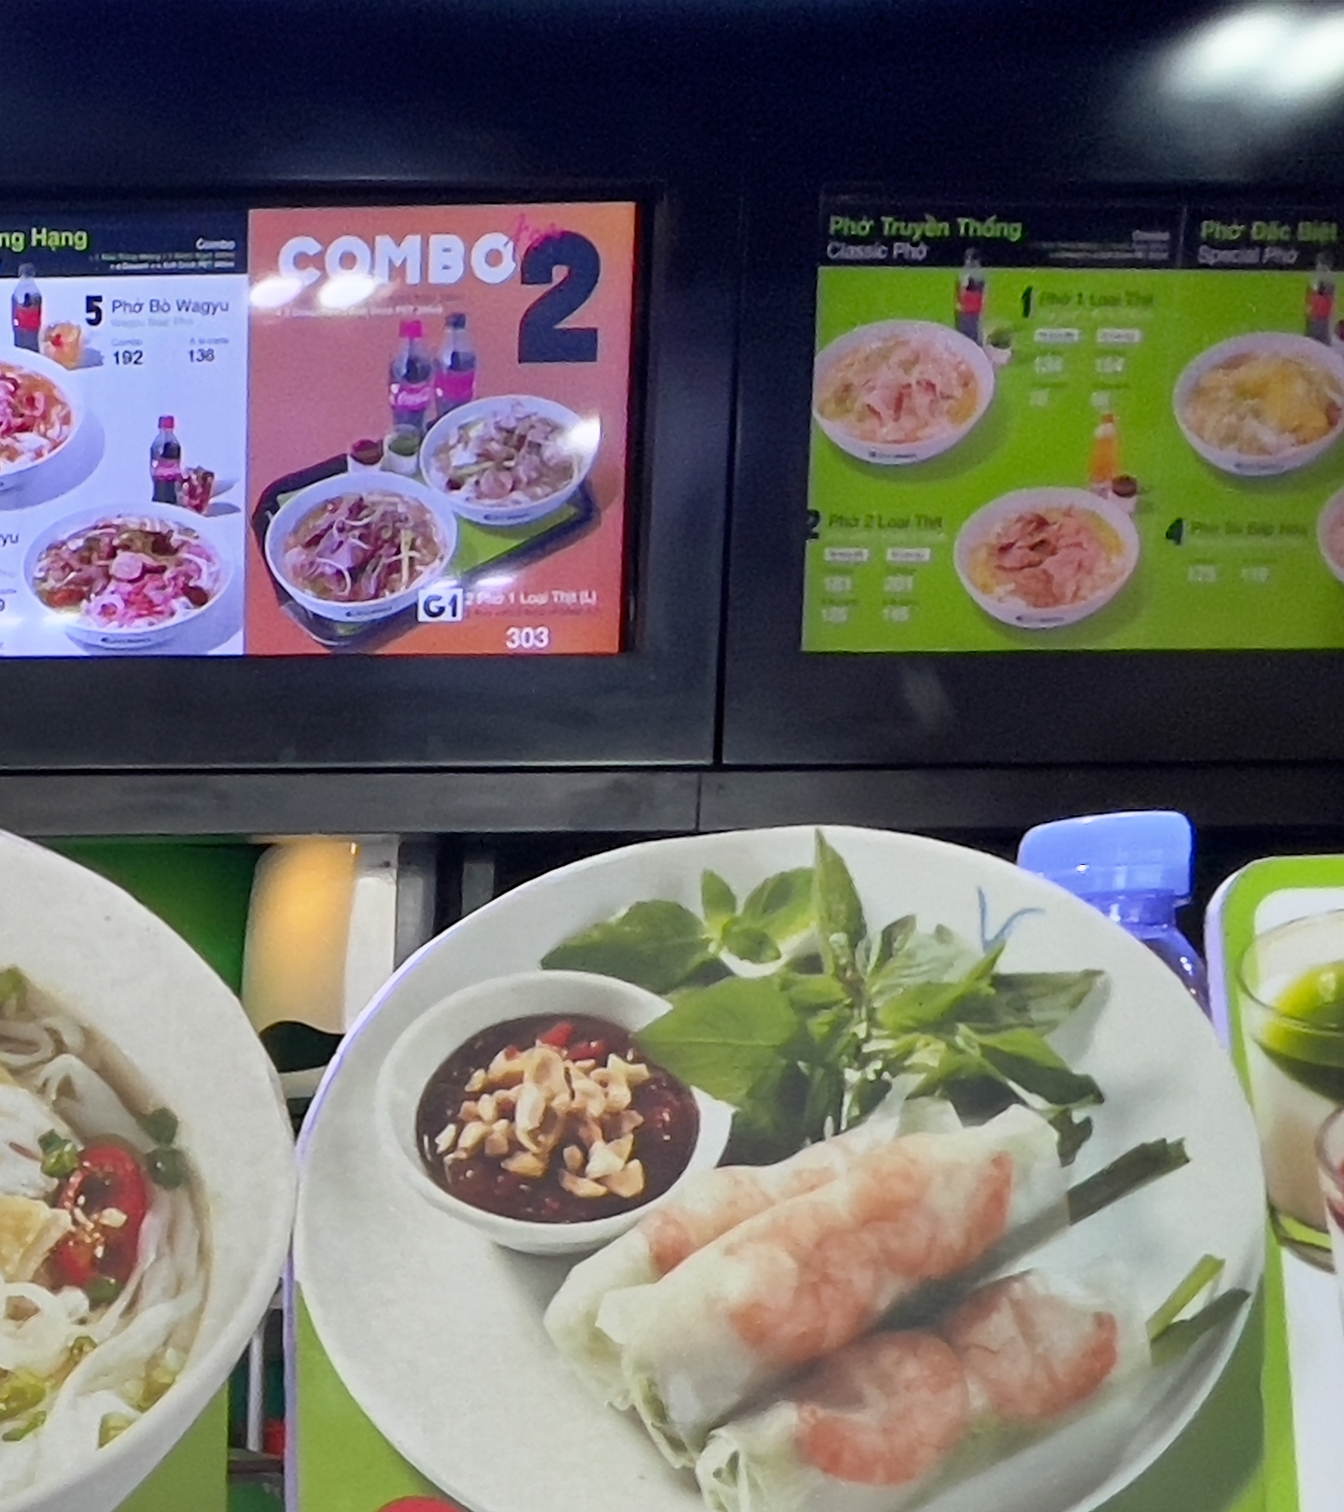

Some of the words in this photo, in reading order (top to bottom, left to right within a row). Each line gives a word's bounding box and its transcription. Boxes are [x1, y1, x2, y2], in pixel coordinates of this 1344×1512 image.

[31, 227, 88, 251] Hạng
[829, 215, 874, 236] Phở
[880, 213, 950, 241] Truyền
[957, 214, 1023, 242] Thống
[1201, 219, 1246, 241] Phở
[827, 241, 888, 259] Classic
[893, 241, 931, 261] Phở
[1198, 244, 1260, 265] Special
[278, 232, 518, 288] COMBO
[518, 230, 600, 364] 2
[1022, 286, 1032, 318] 1
[86, 295, 103, 326] 5
[112, 298, 144, 313] Phở
[150, 298, 171, 313] Bò
[176, 298, 230, 315] Wagyu
[423, 593, 458, 618] G1
[506, 626, 550, 649] 303
